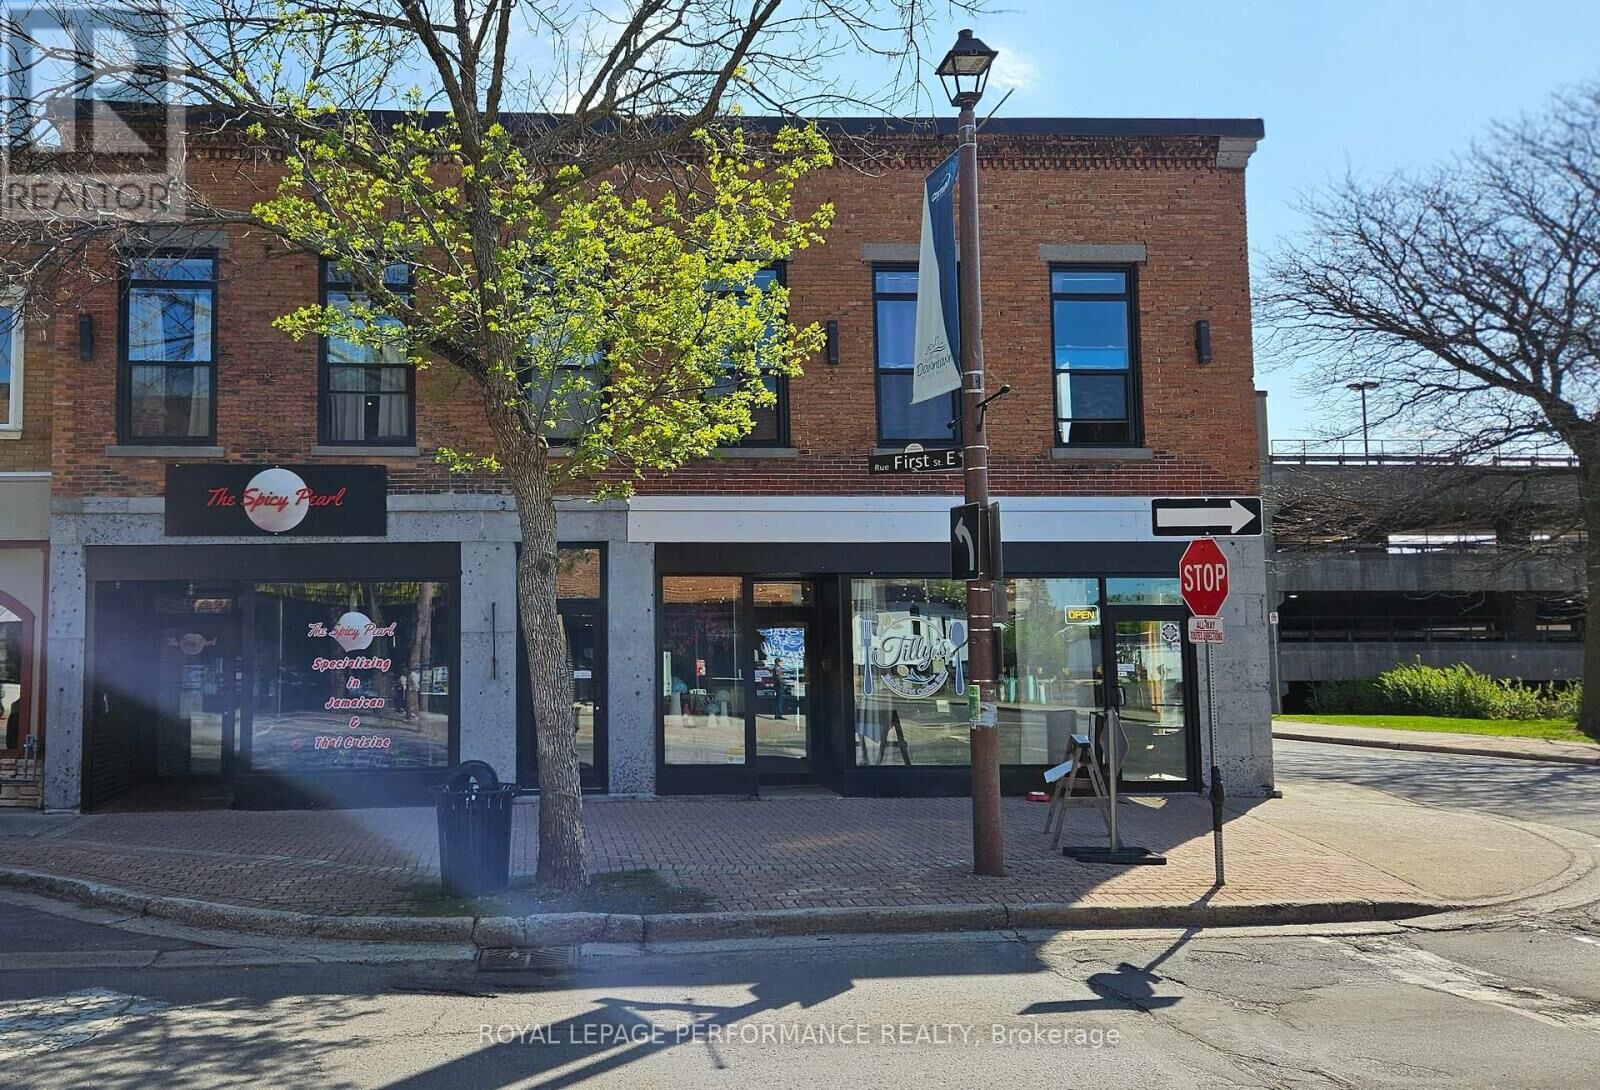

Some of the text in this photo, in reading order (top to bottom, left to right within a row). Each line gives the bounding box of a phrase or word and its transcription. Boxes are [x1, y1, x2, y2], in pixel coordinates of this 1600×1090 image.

[874, 451, 956, 472] Rue First St. E
[206, 487, 346, 512] The Spicy Pearl
[1184, 563, 1226, 592] STOP
[1068, 610, 1095, 620] OPEN
[308, 622, 397, 640] The Spicy Pearl
[873, 635, 948, 671] Tilly's
[312, 656, 391, 672] Specializing
[346, 676, 360, 689] in
[325, 696, 385, 709] Jamaican
[349, 716, 360, 729] &
[315, 736, 391, 750] Thai Cuisine
